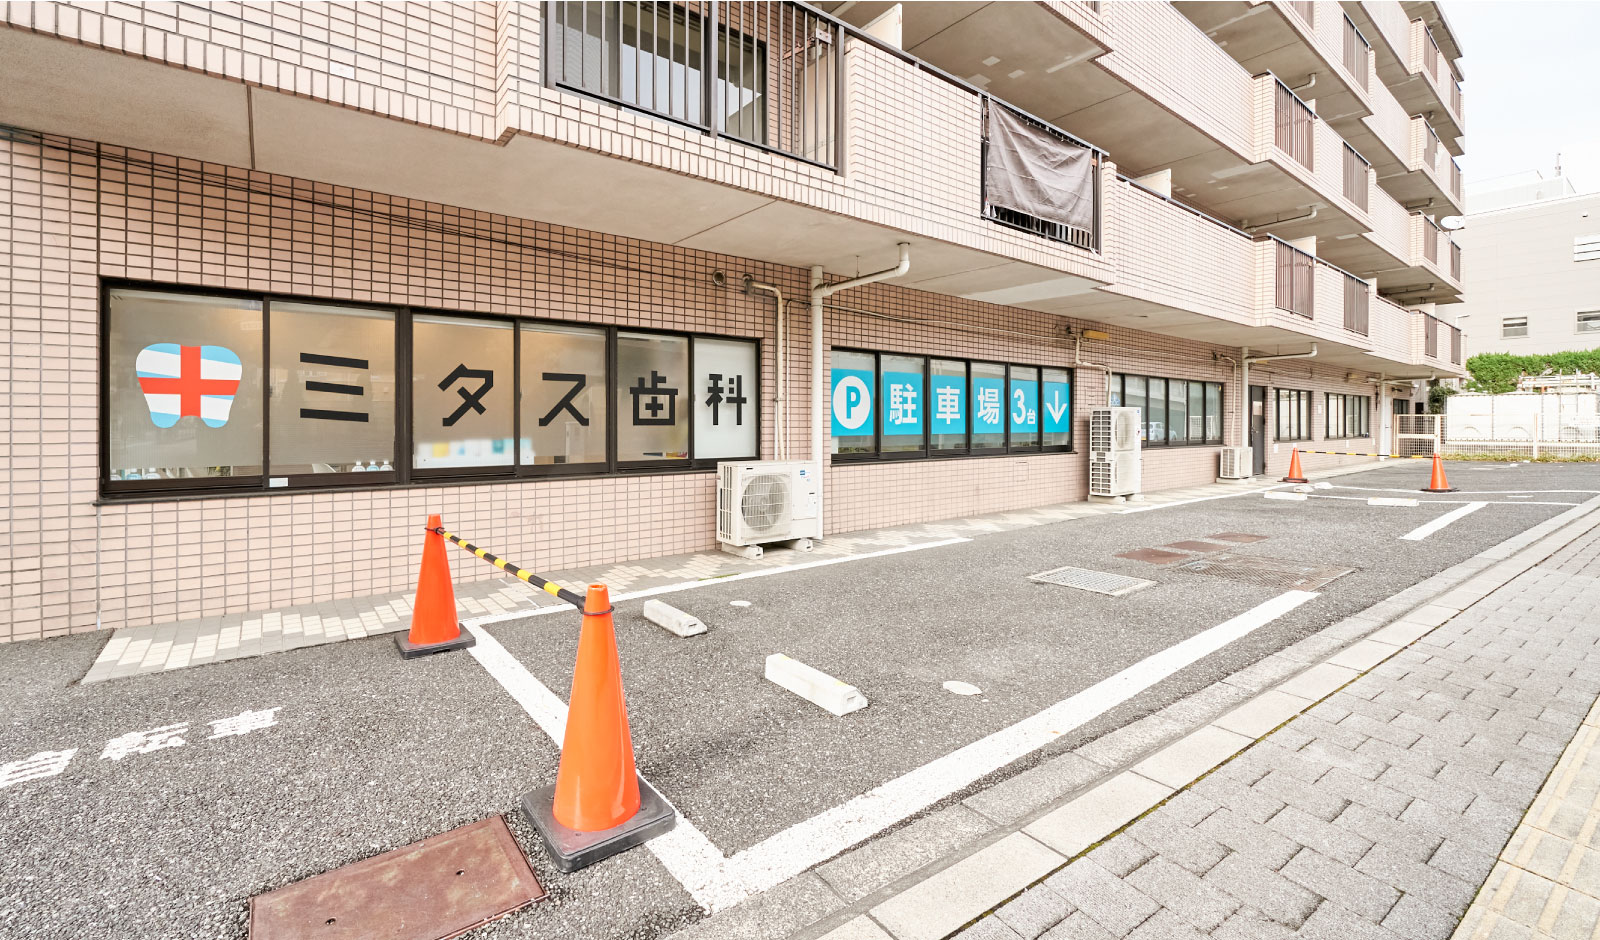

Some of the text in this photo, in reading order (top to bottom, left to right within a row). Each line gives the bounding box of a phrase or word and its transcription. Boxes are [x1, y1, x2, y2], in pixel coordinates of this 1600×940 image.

[299, 352, 747, 427] ミタス歯科
[845, 385, 861, 420] P
